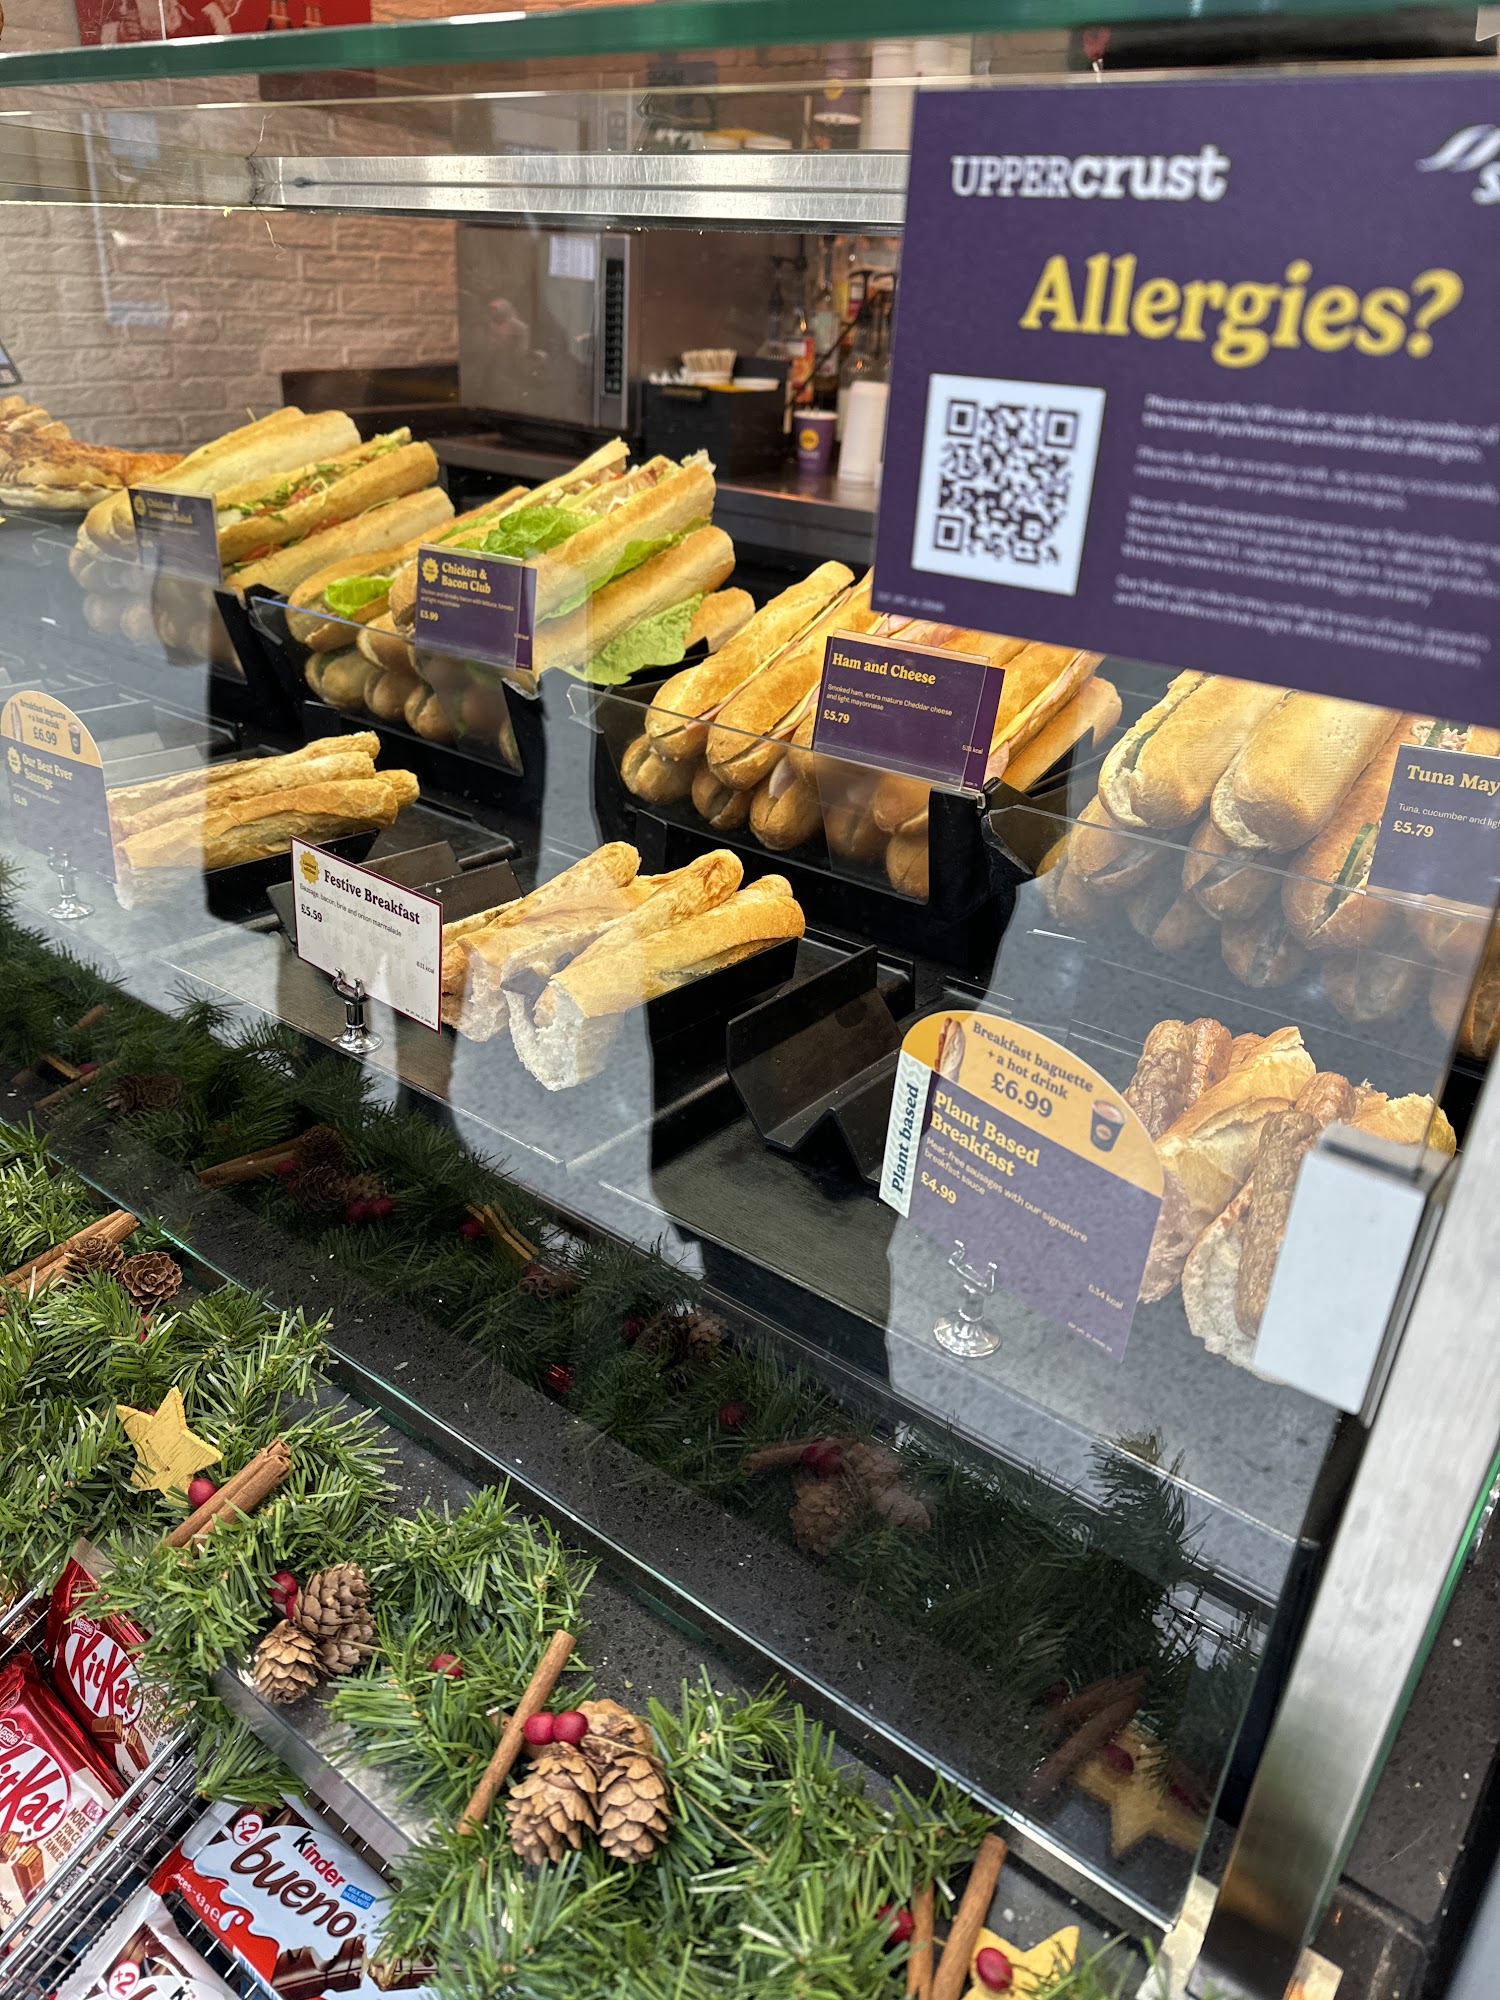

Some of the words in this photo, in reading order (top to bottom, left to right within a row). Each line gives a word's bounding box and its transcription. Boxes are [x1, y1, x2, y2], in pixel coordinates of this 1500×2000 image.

[950, 143, 1231, 201] UPPERcrust
[1019, 252, 1464, 369] Allergies?
[441, 575, 468, 590] Bacon
[470, 581, 491, 594] Club
[442, 562, 477, 578] Chicken
[479, 568, 488, 580] &
[420, 609, 439, 621] £5.99
[832, 652, 861, 670] Ham
[863, 661, 888, 676] and
[890, 664, 936, 685] Cheese
[826, 693, 837, 701] and
[837, 694, 851, 705] light
[851, 698, 884, 712] mayonnaise
[827, 683, 851, 694] Smoked
[851, 688, 864, 698] ham,
[865, 691, 881, 701] extra
[881, 695, 903, 705] mature
[904, 699, 930, 712] Cheddar
[930, 705, 953, 717] cheese
[45, 718, 60, 729] drink
[823, 709, 850, 724] £5.79
[33, 726, 57, 746] £6.99
[22, 753, 36, 768] Our
[37, 758, 54, 775] Best
[54, 764, 73, 781] Ever
[24, 768, 54, 790] Sausage
[1407, 765, 1455, 786] Tuna
[1459, 773, 1500, 797] May
[1393, 820, 1434, 838] £5.79
[1398, 803, 1421, 815] Tuna,
[1423, 808, 1468, 822] cucumber
[1469, 815, 1487, 825] and
[299, 883, 320, 900] Sausage,
[320, 890, 336, 907] bacon,
[336, 900, 347, 913] brie
[347, 906, 358, 918] and
[357, 911, 373, 923] onion
[373, 918, 402, 937] marmalade
[300, 903, 323, 923] £5.59
[324, 869, 362, 898] Festive
[364, 887, 421, 925] Breakfast
[425, 966, 435, 975] kcal
[972, 1020, 1033, 1063] Breakfast
[1034, 1050, 1094, 1093] baguette
[988, 1050, 996, 1060] +
[996, 1054, 1005, 1065] a
[1007, 1056, 1029, 1080] hot
[1031, 1068, 1068, 1100] drink
[991, 1072, 1054, 1119] £6.99
[899, 1082, 919, 1142] based
[930, 1111, 1016, 1177] Breakfast
[933, 1090, 980, 1132] Plant
[982, 1119, 1041, 1167] Based
[891, 1143, 910, 1194] Plant
[924, 1150, 961, 1180] breakfast
[961, 1175, 986, 1196] sauce
[920, 1171, 958, 1205] £4.99
[926, 1136, 965, 1168] Meat-free
[966, 1162, 1004, 1194] sausages
[1004, 1186, 1025, 1207] with
[1025, 1200, 1042, 1216] our
[1042, 1209, 1088, 1244] signature
[1106, 1294, 1124, 1310] kcal
[0, 1743, 65, 1832] tKat
[62, 1823, 75, 1837] FOR
[67, 1807, 90, 1832] MORE
[53, 1830, 73, 1853] FARMIN
[173, 1873, 192, 1892] eces
[196, 1892, 206, 1907] 43
[230, 1832, 357, 1937] bueno
[348, 1886, 361, 1896] MILK
[361, 1893, 372, 1902] AND
